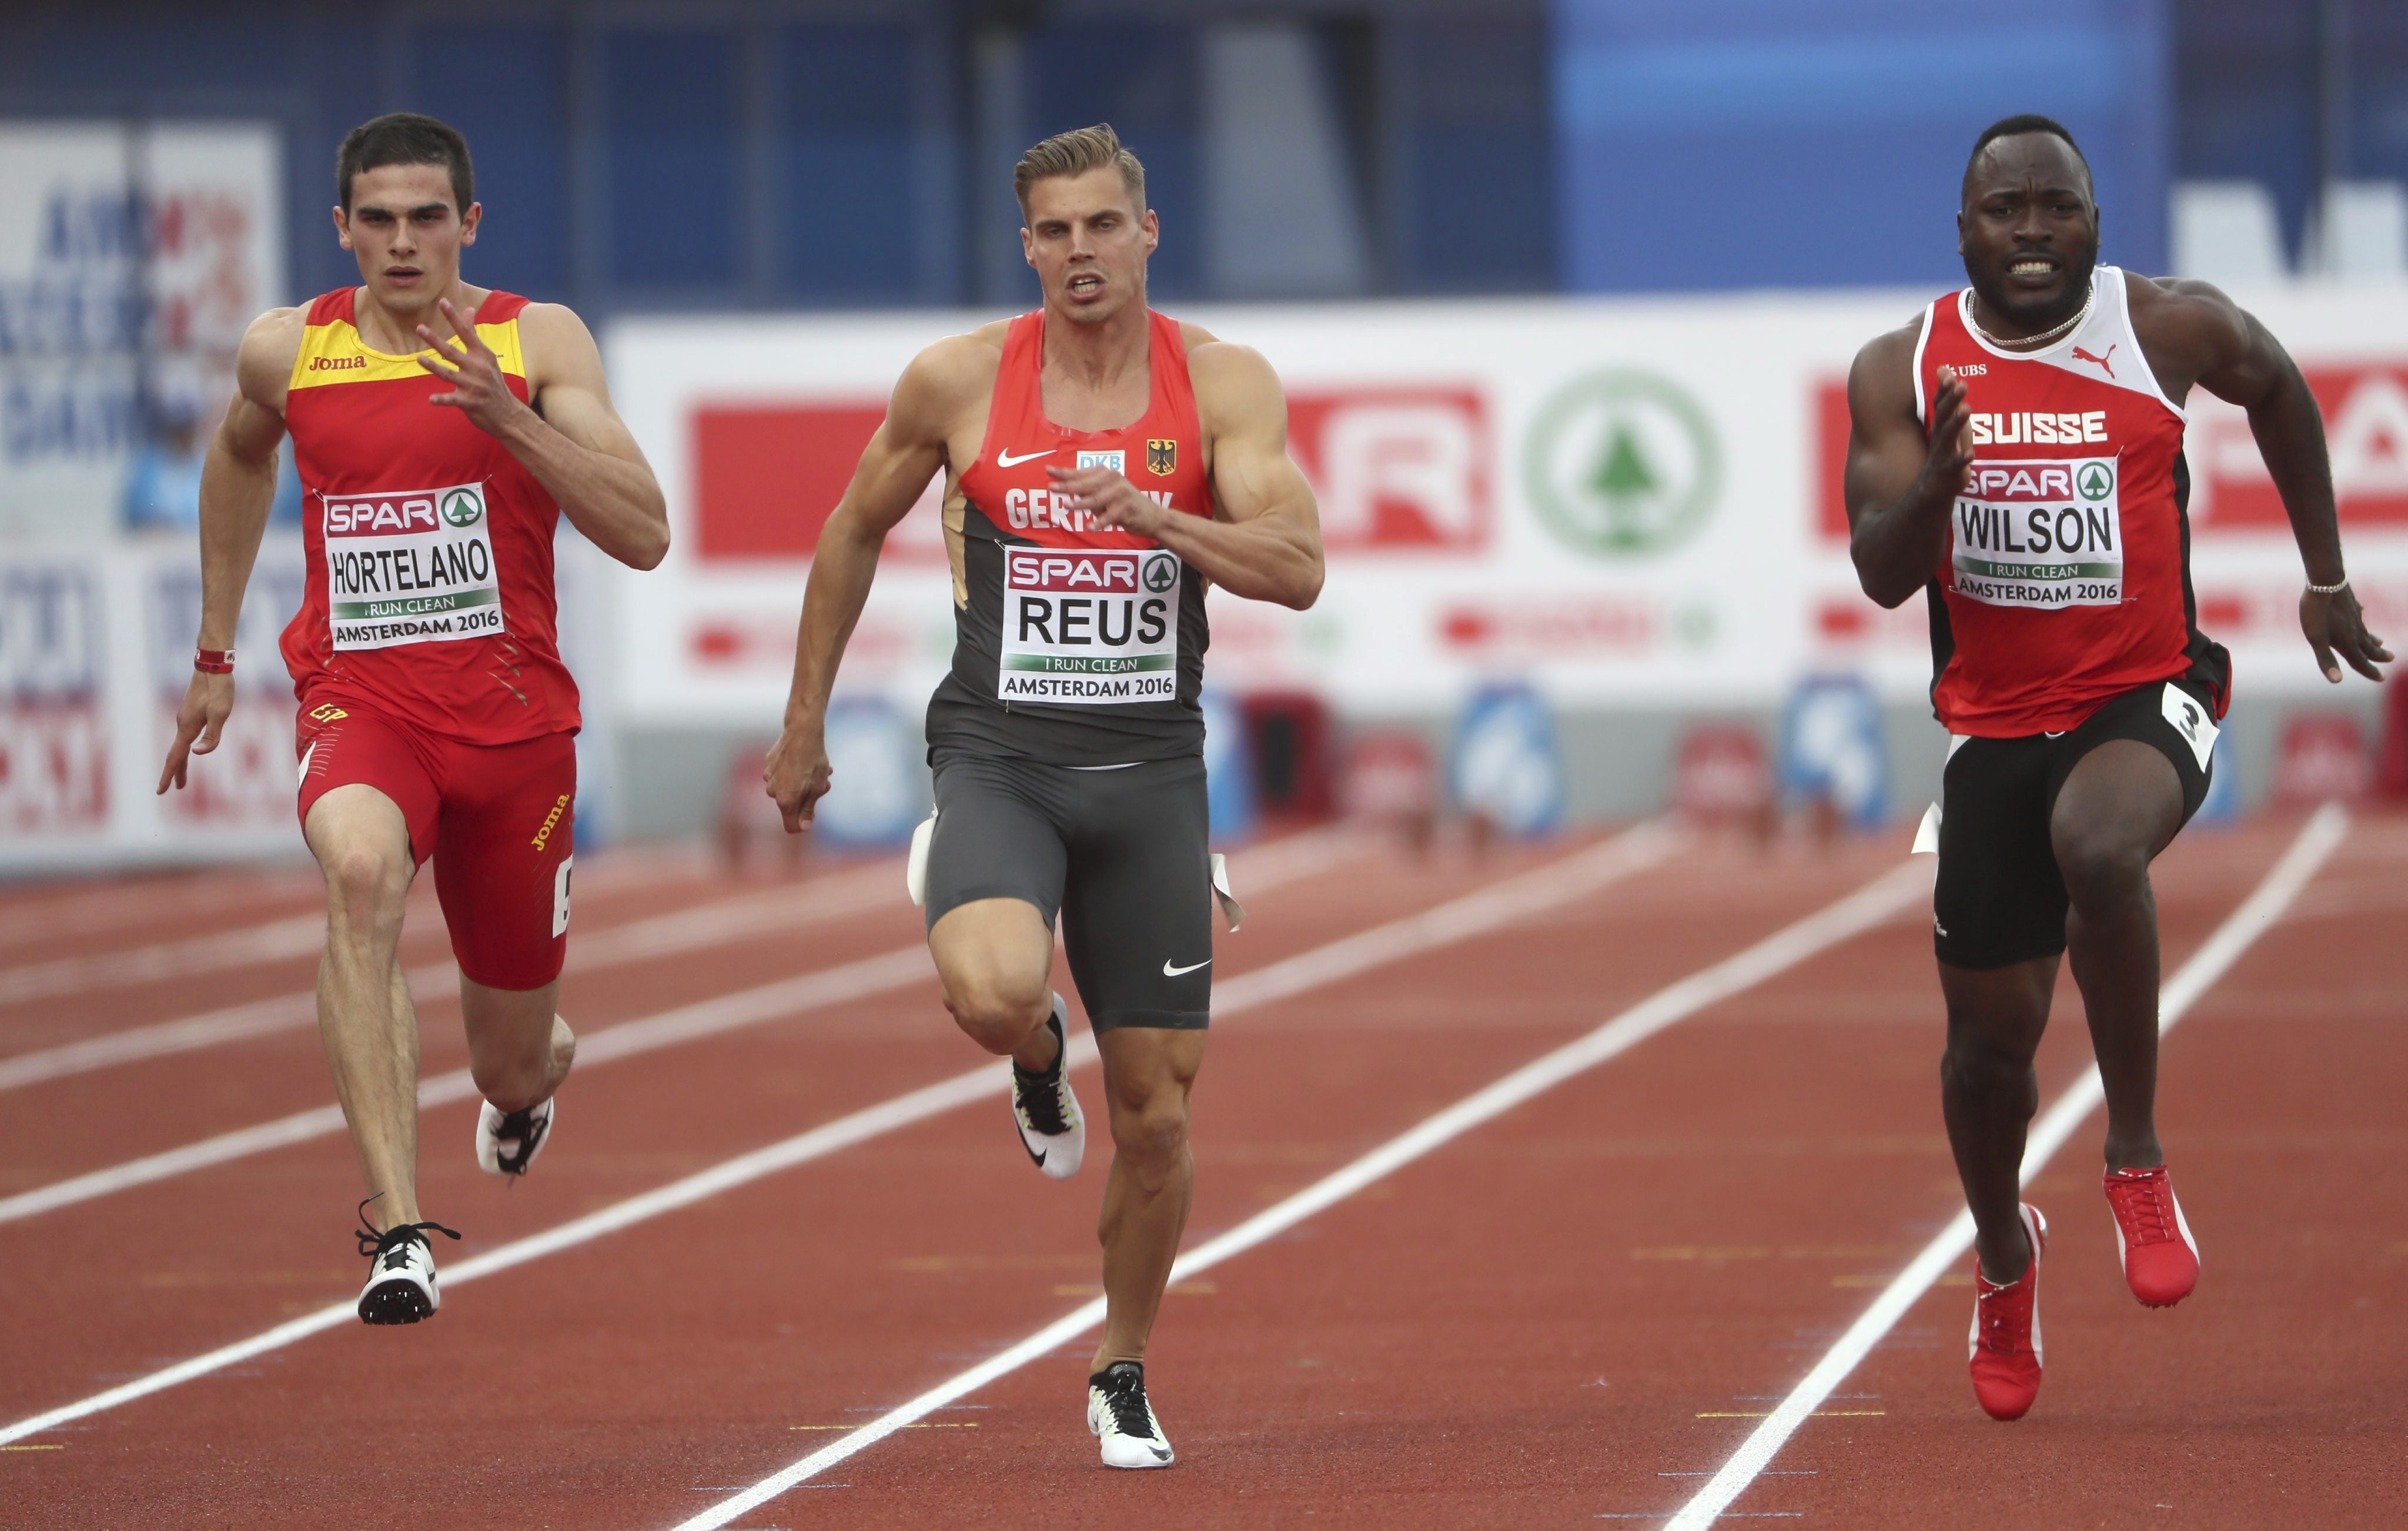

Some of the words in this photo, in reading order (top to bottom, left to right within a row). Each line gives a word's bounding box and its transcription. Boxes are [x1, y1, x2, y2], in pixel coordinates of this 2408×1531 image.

[309, 355, 367, 371] Joma
[1958, 363, 1987, 377] UBS
[1972, 410, 2108, 445] SUISSE
[1080, 455, 1121, 470] DKB
[328, 499, 436, 532] SPAR
[1959, 502, 2112, 553] WILSON
[332, 538, 490, 595] HORTELANO
[1012, 557, 1135, 587] SPAR
[1989, 563, 1993, 576] I
[1996, 564, 2028, 577] RUN
[2032, 565, 2079, 579] CLEAN
[1959, 577, 2072, 603] AMSTERDAM
[2076, 584, 2117, 599] 2016
[370, 601, 402, 616] RUN
[406, 596, 456, 613] CLEAN
[336, 619, 452, 643] AMSTERDAM
[457, 610, 499, 632] 2016
[1019, 596, 1168, 646] REUS
[1045, 654, 1049, 670] I
[1054, 655, 1086, 672] RUN
[1091, 658, 1138, 672] CLEAN
[1004, 677, 1130, 697] AMSTERDAM
[1135, 677, 1173, 695] 2016
[309, 703, 349, 723] ESP
[2179, 701, 2199, 743] 3
[531, 794, 570, 852] Joma
